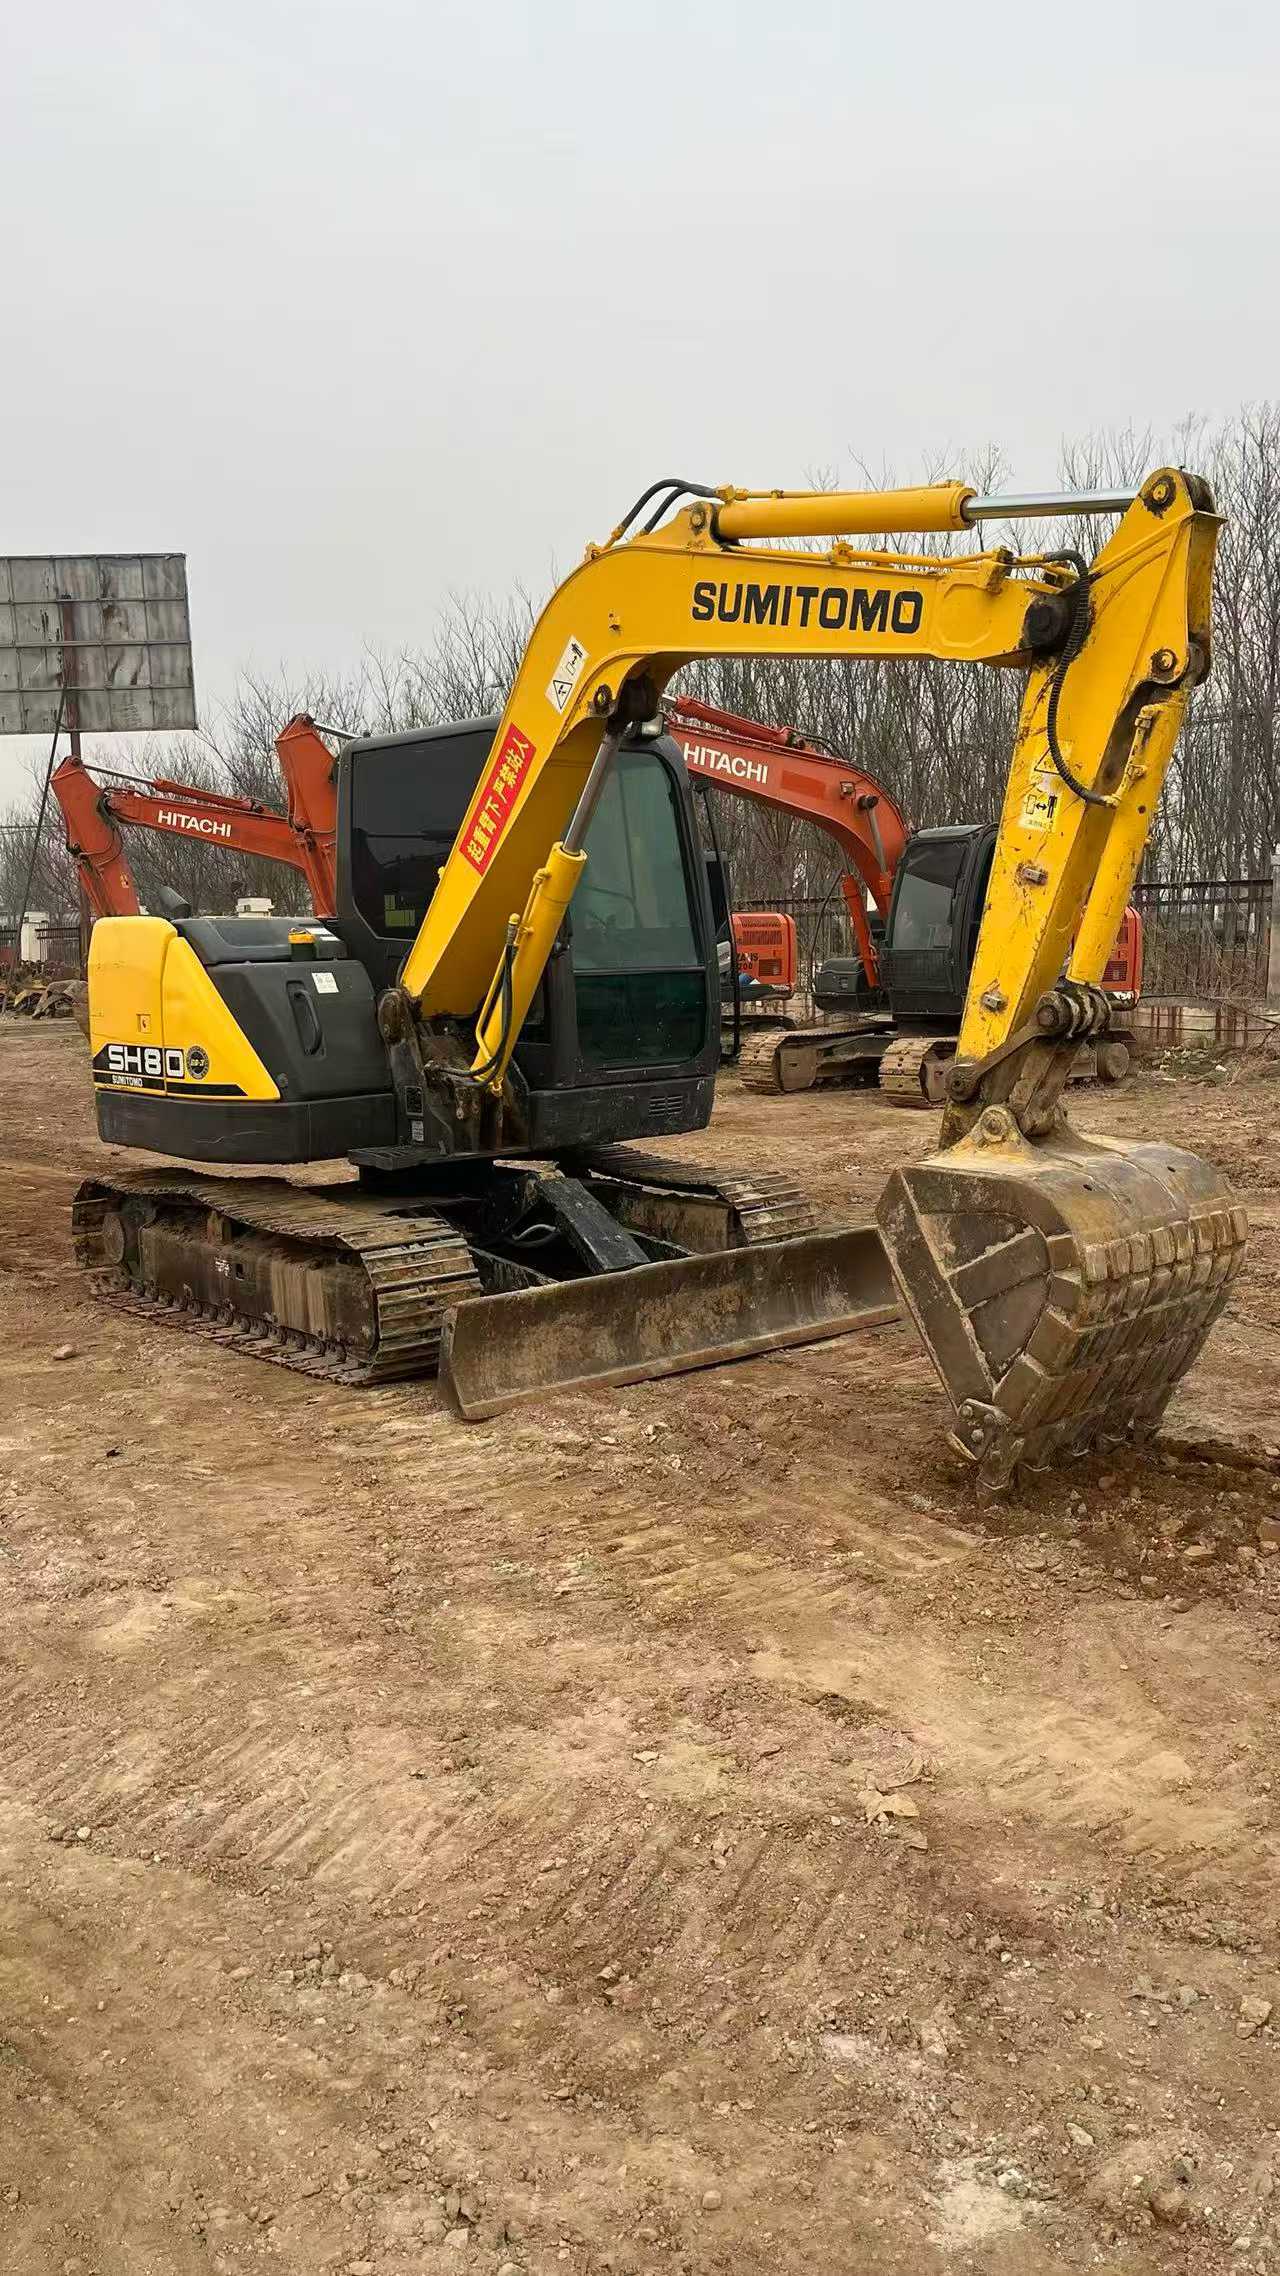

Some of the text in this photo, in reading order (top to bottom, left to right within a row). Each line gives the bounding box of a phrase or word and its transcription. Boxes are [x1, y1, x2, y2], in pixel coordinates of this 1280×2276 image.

[691, 581, 924, 634] SUMITOMO
[683, 742, 769, 784] HITACHI
[157, 809, 232, 838] HITACHI
[107, 1044, 184, 1078] SH80
[111, 1074, 143, 1088] SUMITOMO
